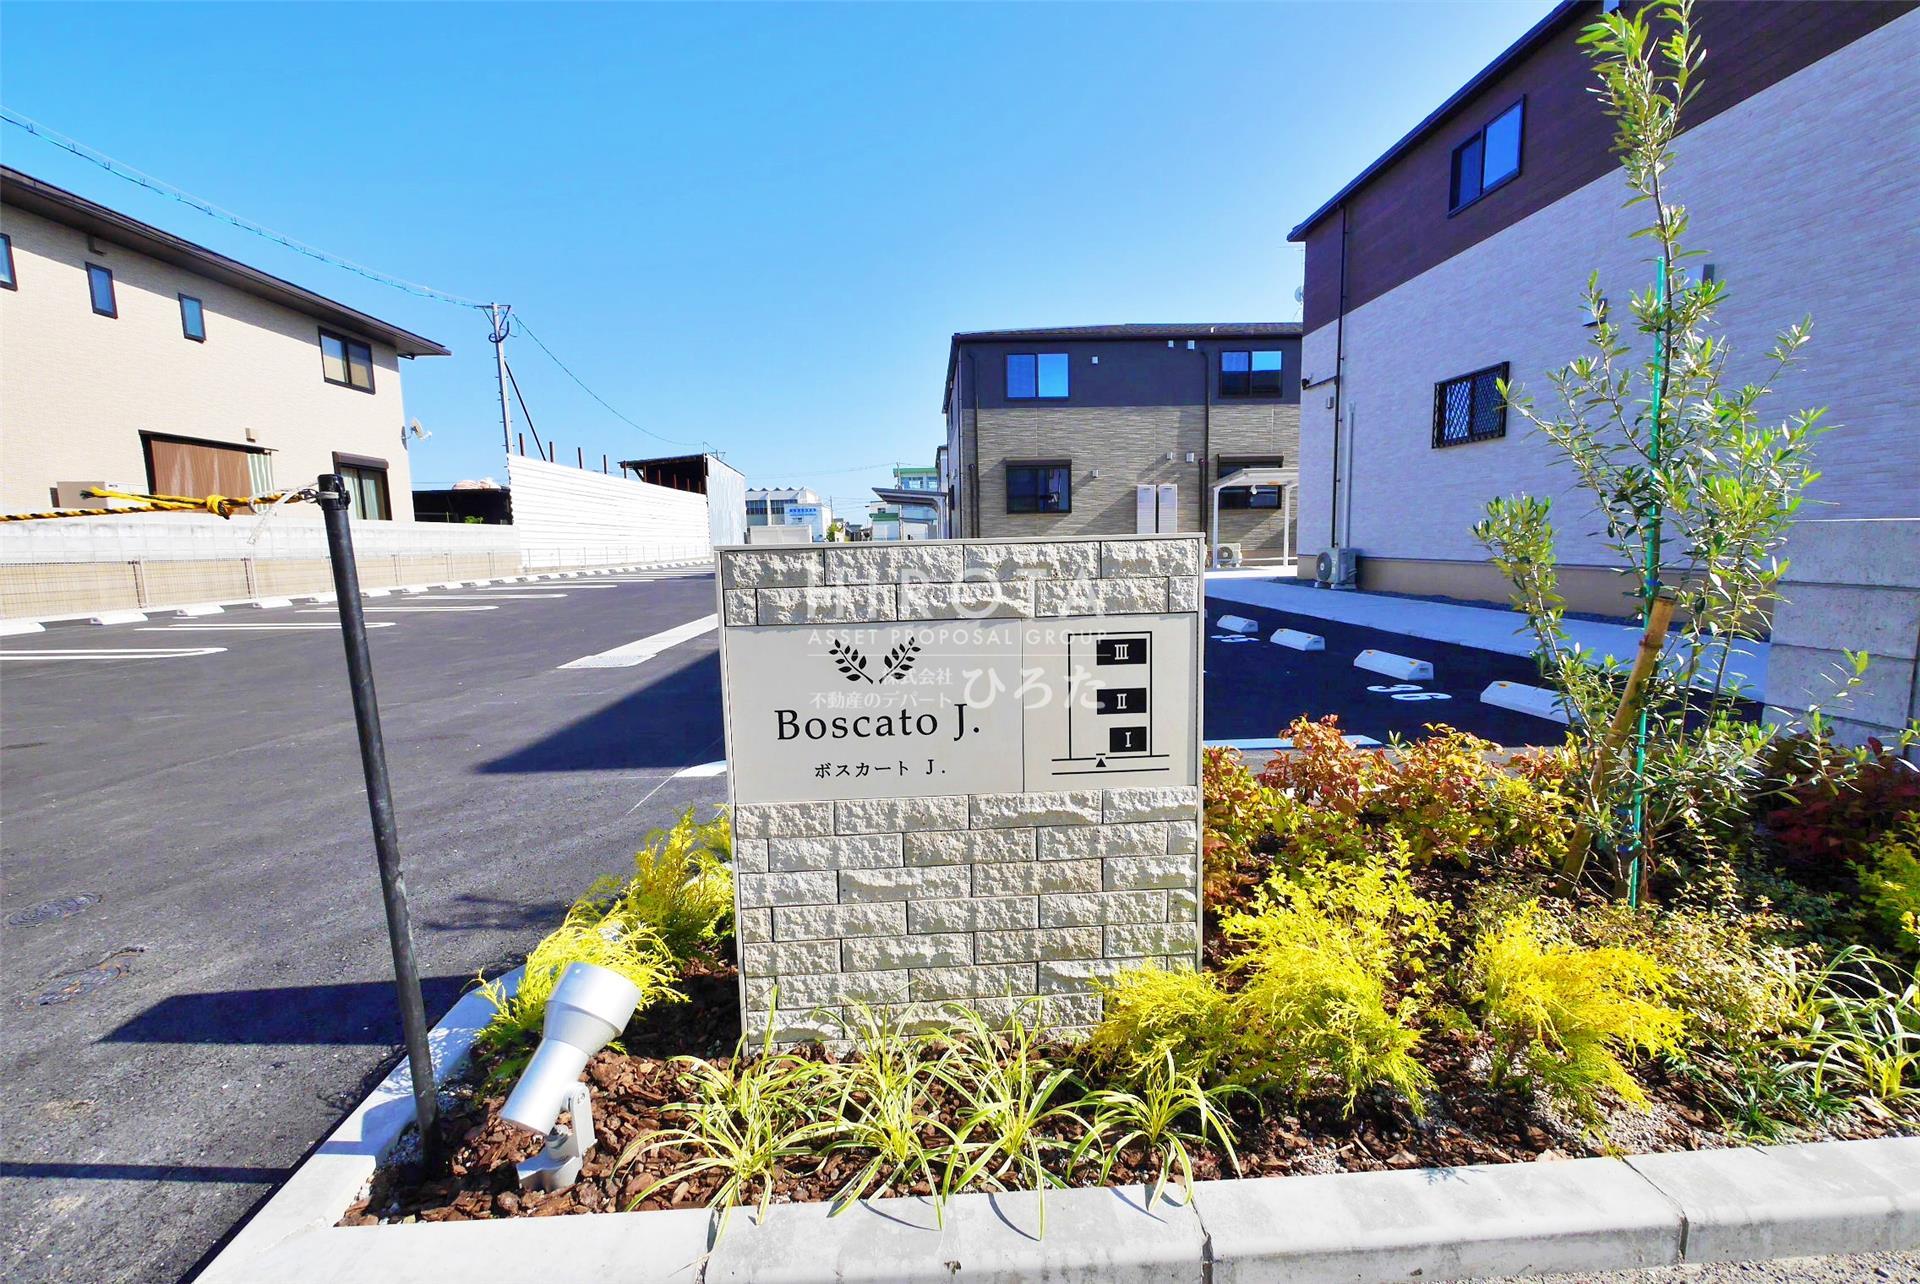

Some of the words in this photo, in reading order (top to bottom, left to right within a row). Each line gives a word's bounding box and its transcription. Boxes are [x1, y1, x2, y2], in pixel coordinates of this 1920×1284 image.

[774, 708, 938, 740] Boscato
[953, 703, 980, 741] J.
[814, 760, 909, 778] ボスカート
